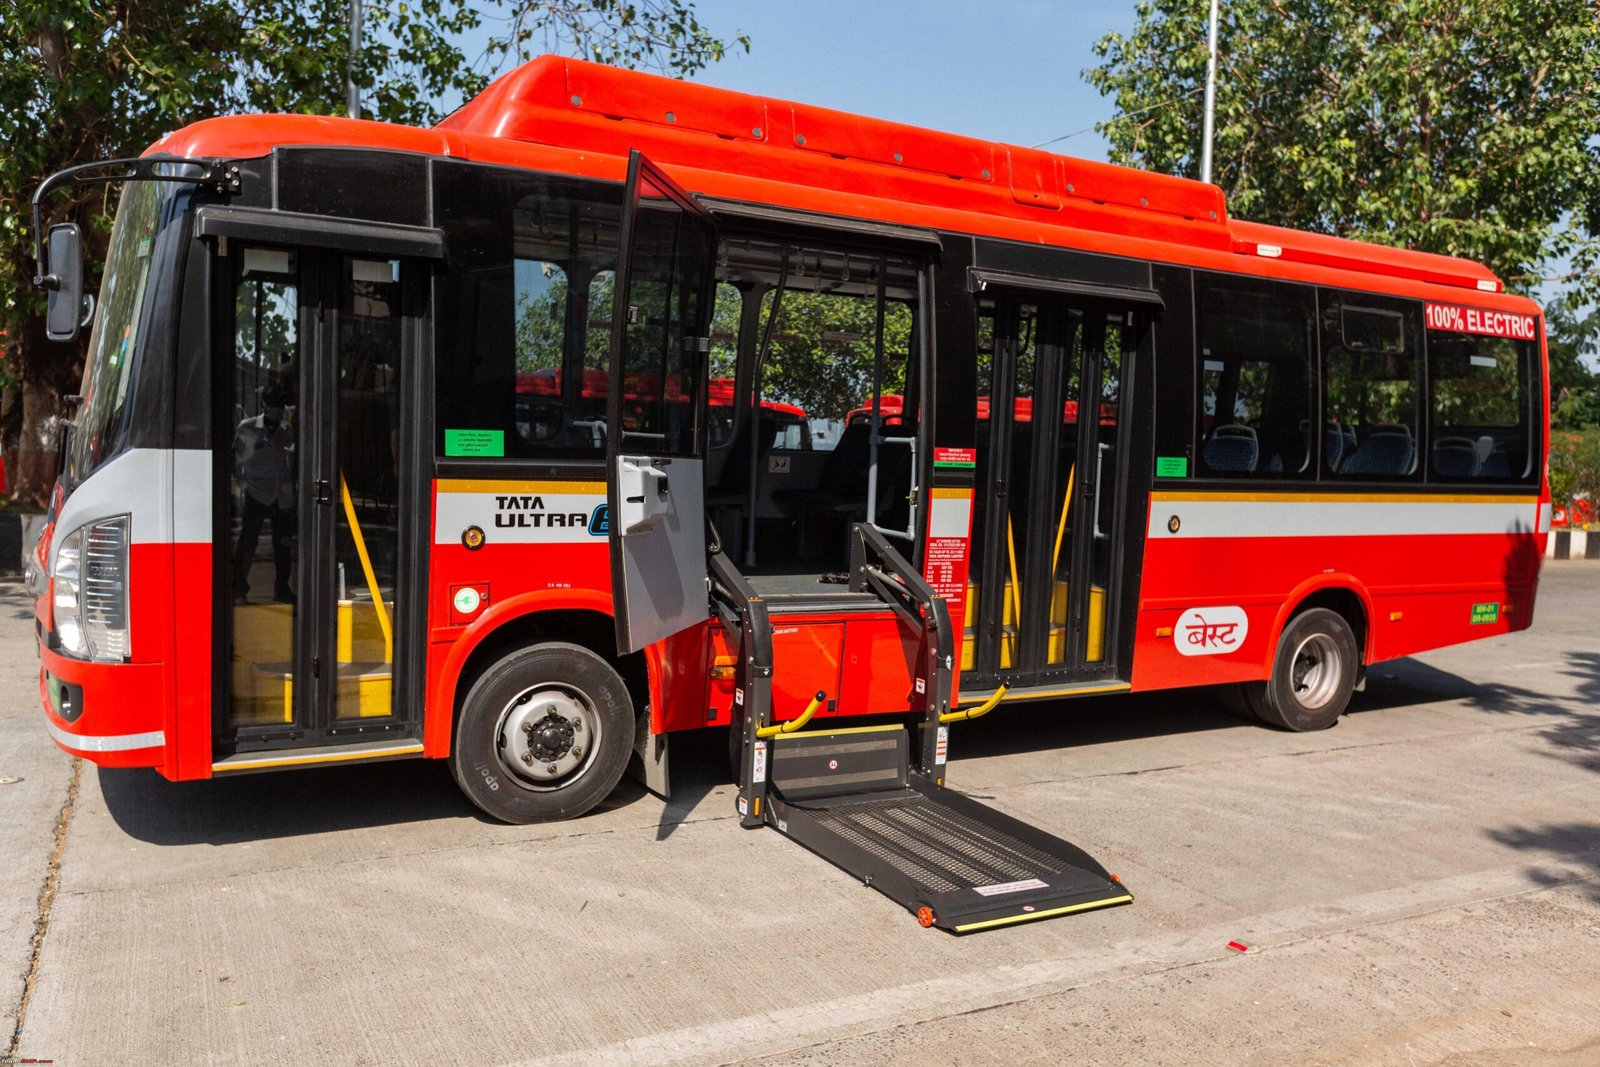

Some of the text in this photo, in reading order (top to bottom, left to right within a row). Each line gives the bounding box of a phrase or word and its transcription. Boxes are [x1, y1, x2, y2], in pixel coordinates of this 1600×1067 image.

[1426, 304, 1535, 338] 100% ELECTRIC
[495, 496, 545, 510] TATA
[495, 513, 588, 528] ULTRA
[1185, 613, 1239, 648] बेस्ट
